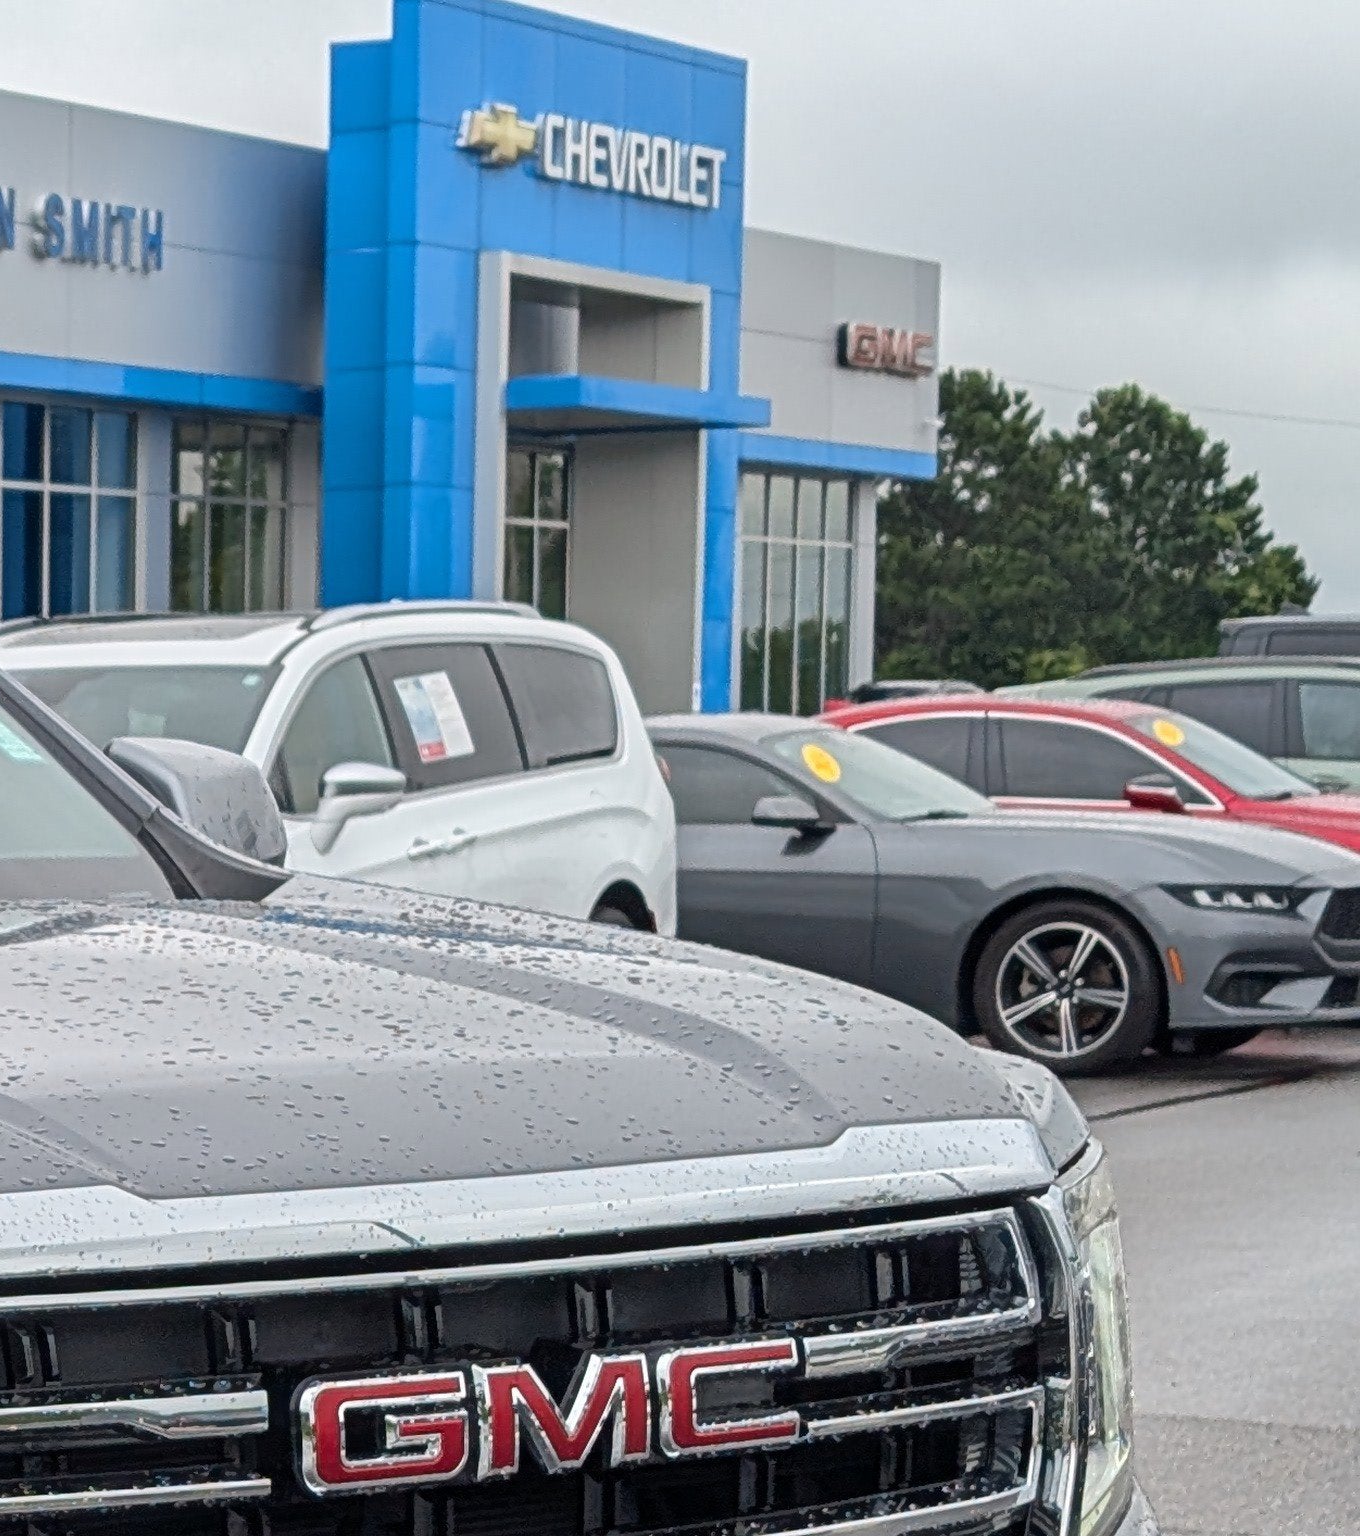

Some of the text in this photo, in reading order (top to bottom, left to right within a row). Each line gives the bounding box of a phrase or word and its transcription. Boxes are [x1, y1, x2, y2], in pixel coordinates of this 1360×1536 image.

[539, 113, 727, 209] CHEVROLET
[40, 192, 164, 272] SMITH
[847, 322, 935, 378] GMC
[296, 1336, 801, 1498] GMC
